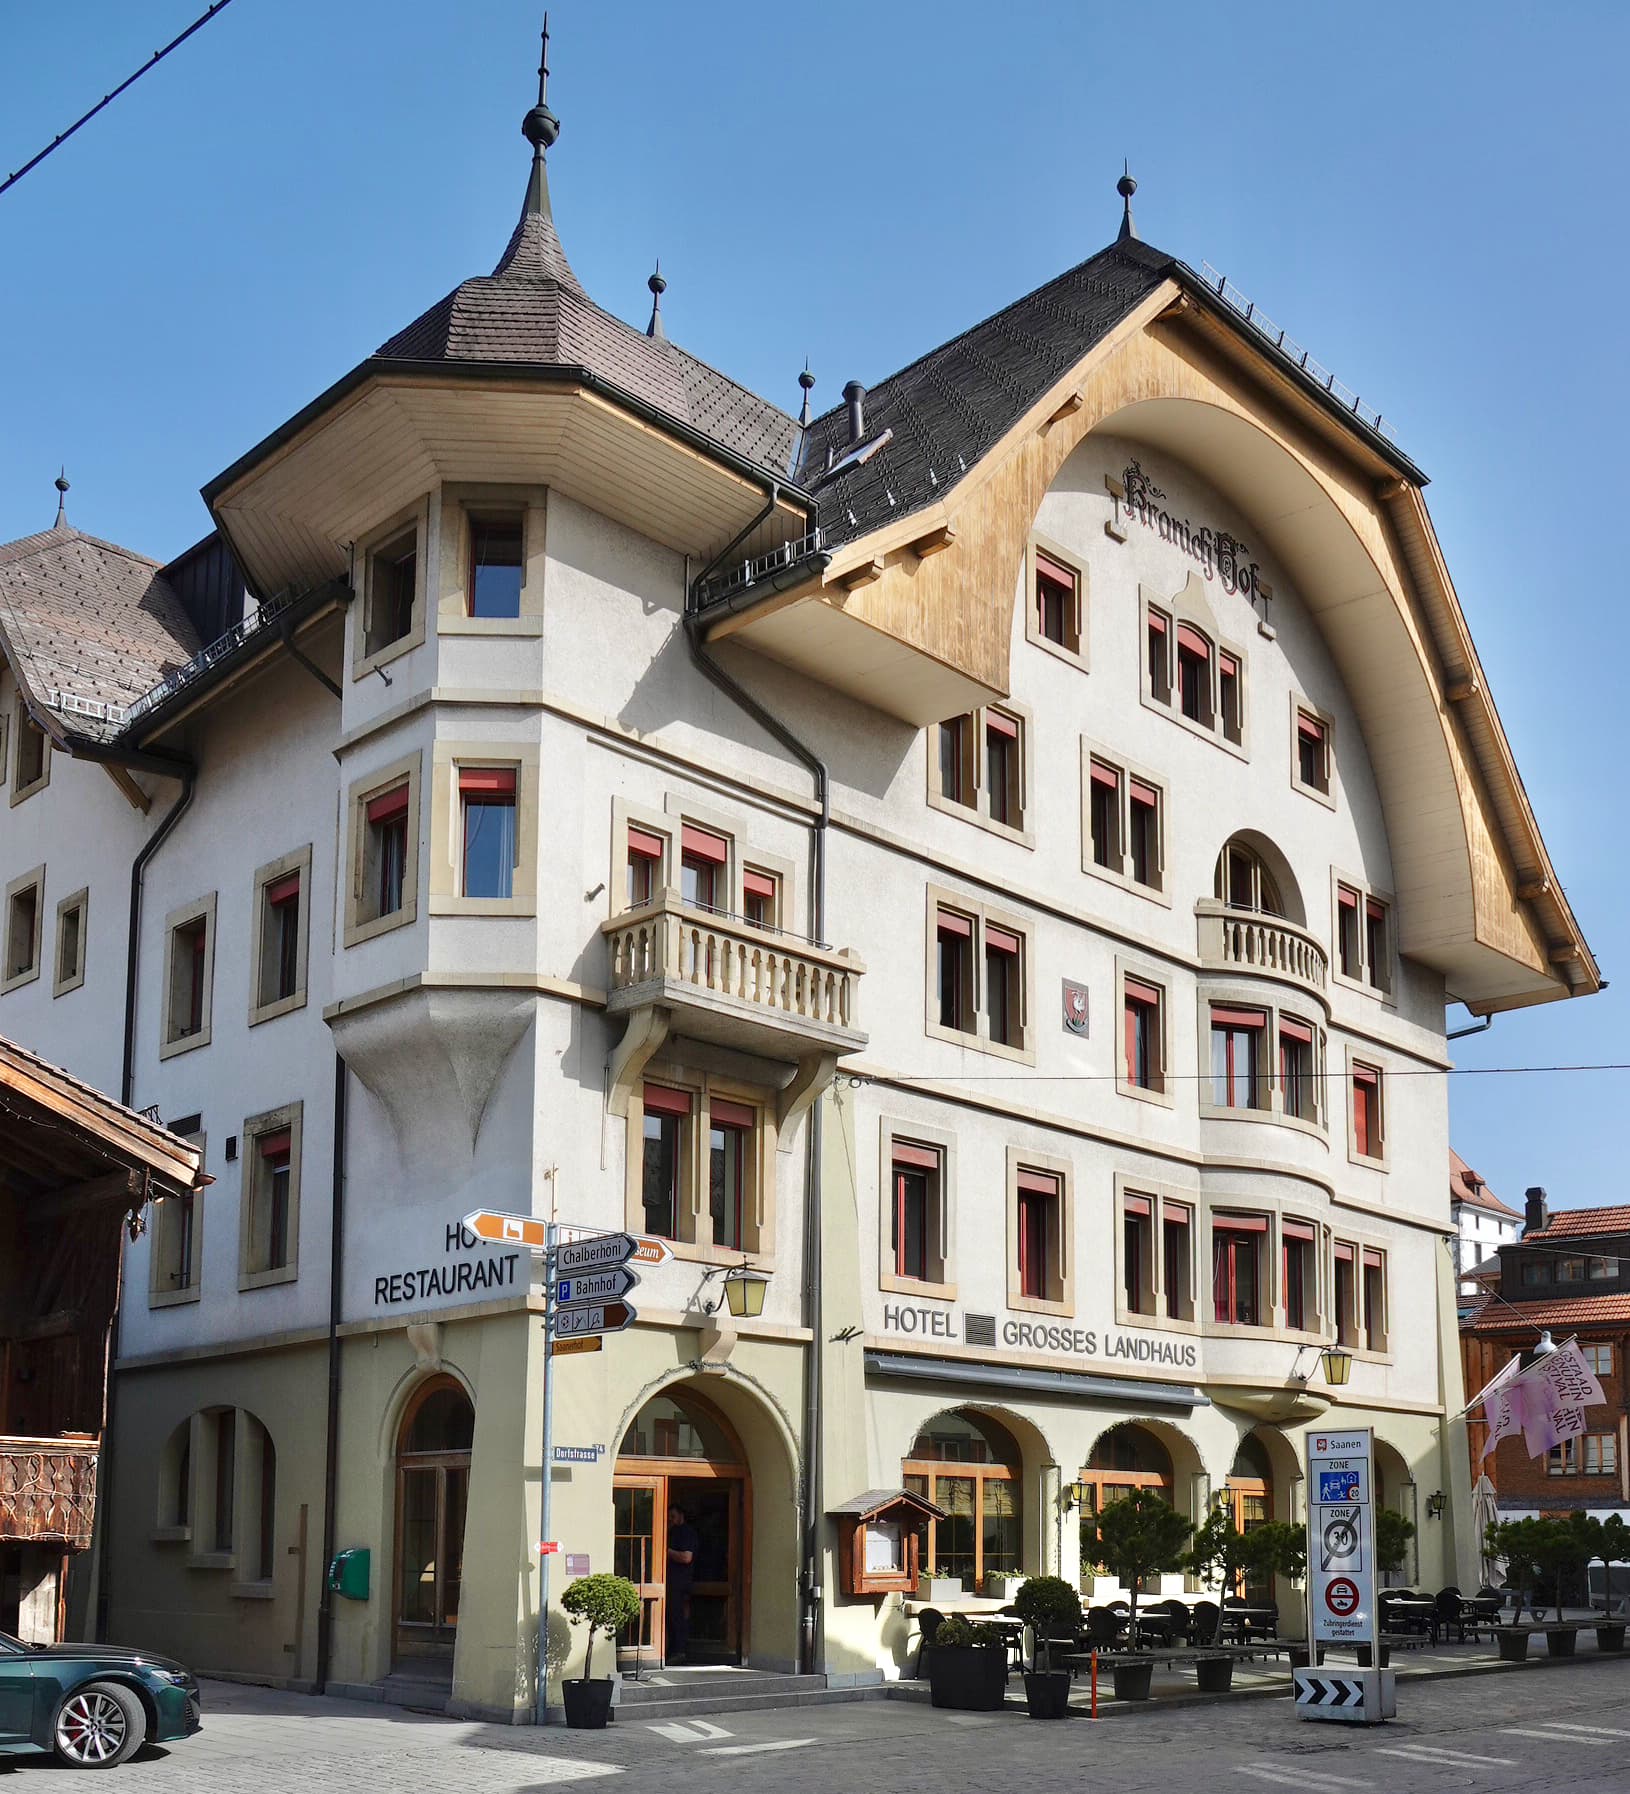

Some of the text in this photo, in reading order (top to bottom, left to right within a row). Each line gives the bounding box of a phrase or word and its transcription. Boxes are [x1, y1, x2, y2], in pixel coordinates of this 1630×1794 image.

[563, 1240, 622, 1265] Chalberhöni
[635, 1245, 659, 1259] seum
[374, 1253, 519, 1305] RESTAURANT
[576, 1273, 617, 1295] Bahnhof
[884, 1303, 1196, 1368] HOTEL GROSSES LANDHAUS
[1559, 1349, 1592, 1395] GSTAAD
[1330, 1440, 1361, 1449] Saanen
[556, 1447, 595, 1460] Dorfstrasse
[1329, 1461, 1349, 1470] ZONE
[1350, 1489, 1359, 1498] 20
[1330, 1509, 1350, 1518] ZONE
[1333, 1530, 1348, 1546] 30
